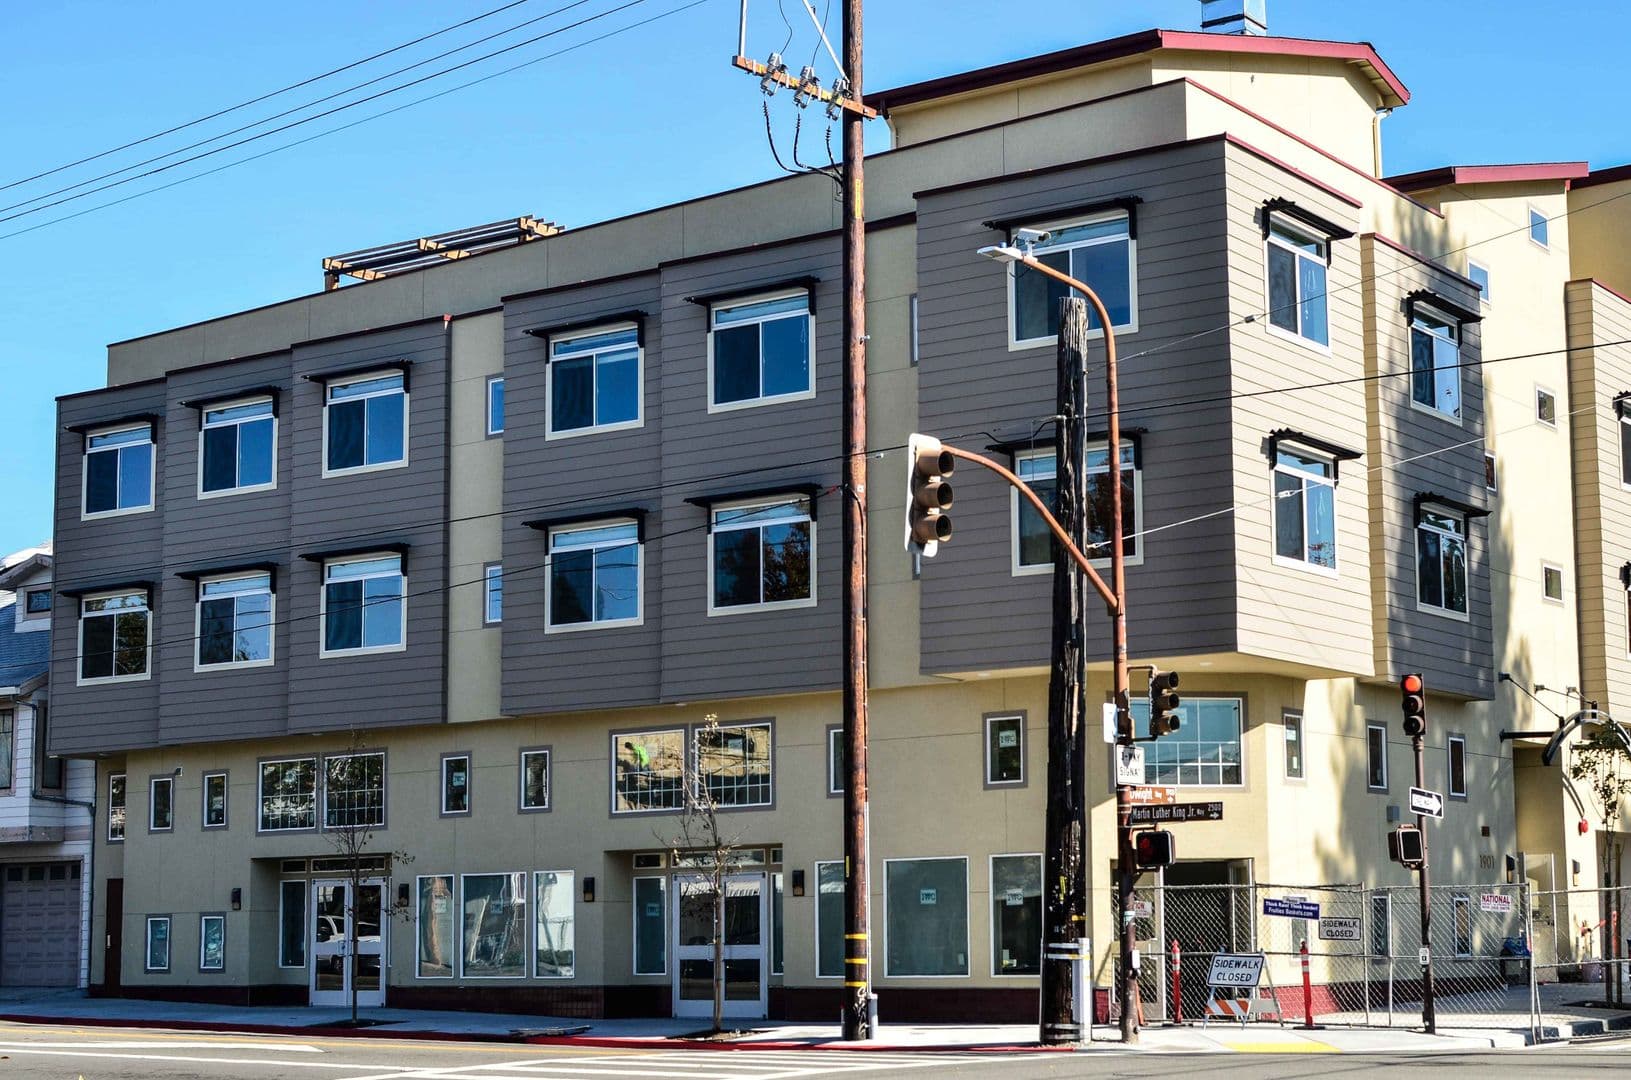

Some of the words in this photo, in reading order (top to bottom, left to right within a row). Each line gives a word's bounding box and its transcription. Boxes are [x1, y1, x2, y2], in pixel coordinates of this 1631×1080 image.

[1132, 808, 1150, 819] Martin
[1152, 807, 1170, 819] Luther
[1172, 806, 1186, 820] King
[1187, 804, 1196, 817] Jr.
[1479, 855, 1495, 869] 1901
[1481, 894, 1511, 904] NATIONAL
[1321, 920, 1358, 928] SIDEWALK
[1326, 930, 1354, 938] CLOSED
[1214, 959, 1260, 969] SIDEWALK
[1216, 972, 1253, 982] CLOSED
